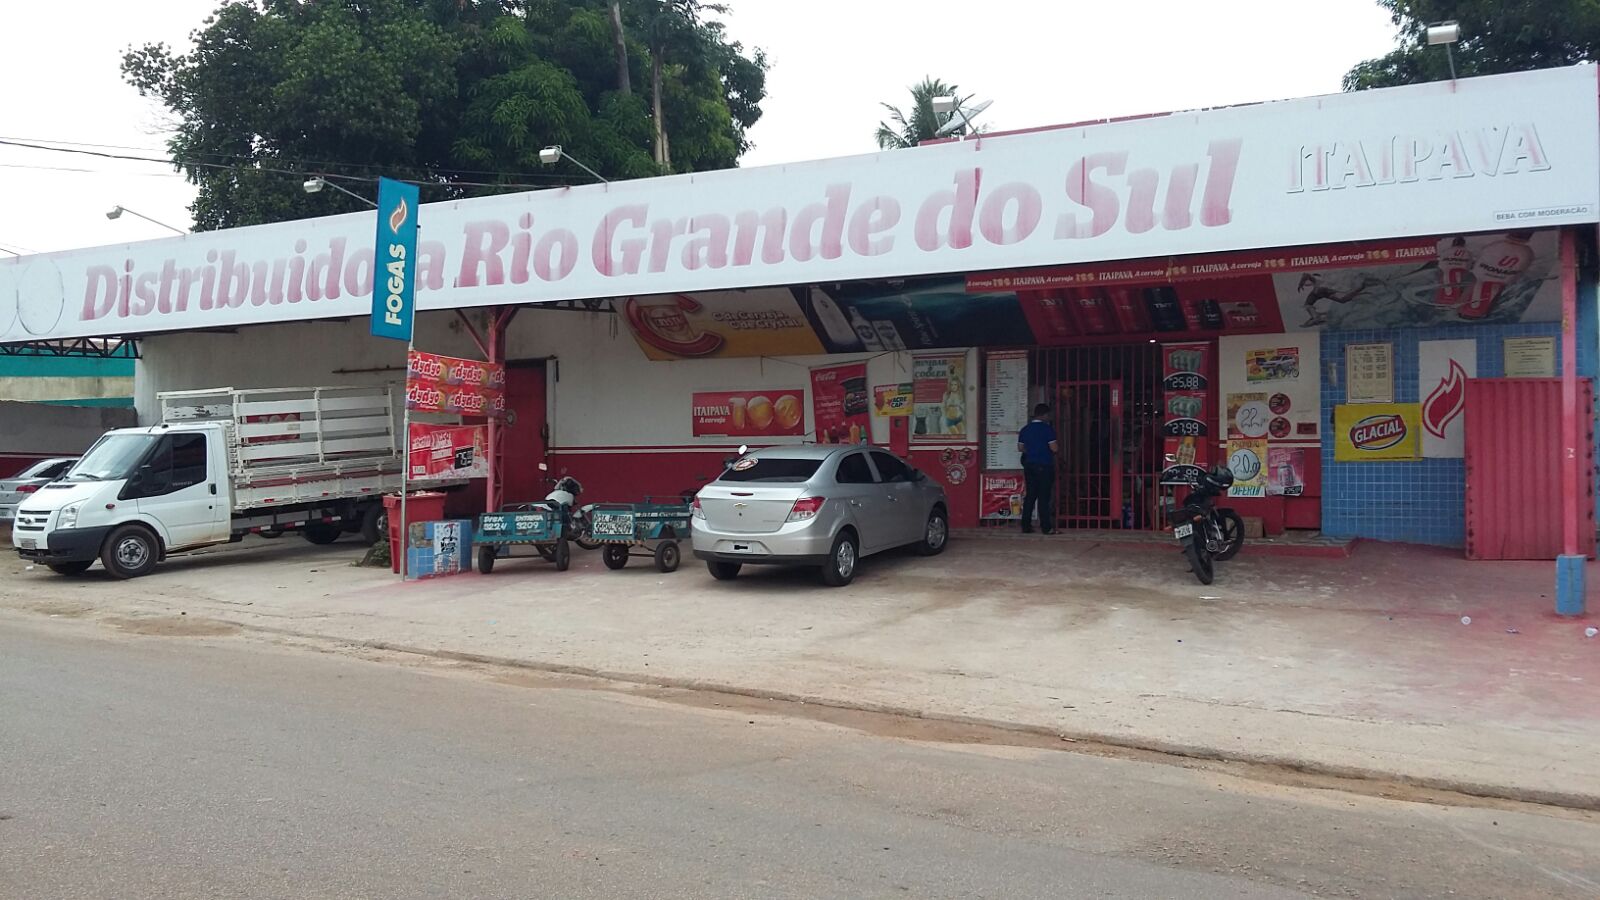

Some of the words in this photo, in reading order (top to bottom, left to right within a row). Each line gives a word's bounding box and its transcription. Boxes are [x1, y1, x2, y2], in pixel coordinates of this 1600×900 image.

[1286, 123, 1551, 193] ITAIPAVA
[1518, 211, 1536, 219] COM
[79, 237, 445, 321] Distribuidoa
[453, 212, 579, 288] Rio
[592, 181, 901, 277] Grande
[914, 167, 1042, 252] do
[1053, 137, 1243, 240] Sul
[1013, 276, 1046, 286] ITAIPAVA
[1099, 270, 1134, 280] ITAIPAVA
[1192, 263, 1229, 274] ITAIPAVA
[1237, 261, 1262, 270] cerveja
[1291, 256, 1329, 266] ITAIPAVA
[1338, 253, 1364, 262] cerveja
[1395, 246, 1436, 258] ITAIPAVA
[385, 243, 407, 326] FOGAS
[411, 356, 441, 376] dydyo
[455, 363, 482, 381] dydyo
[914, 370, 948, 378] COOLER
[1172, 376, 1199, 389] 25,88
[408, 385, 440, 405] dydyo
[454, 391, 482, 408] dydyo
[693, 405, 731, 417] ITAIPAVA
[705, 416, 726, 424] cerveja
[1172, 422, 1199, 436] 27,99
[1355, 419, 1403, 443] GLACIAL
[516, 521, 539, 530] 3209
